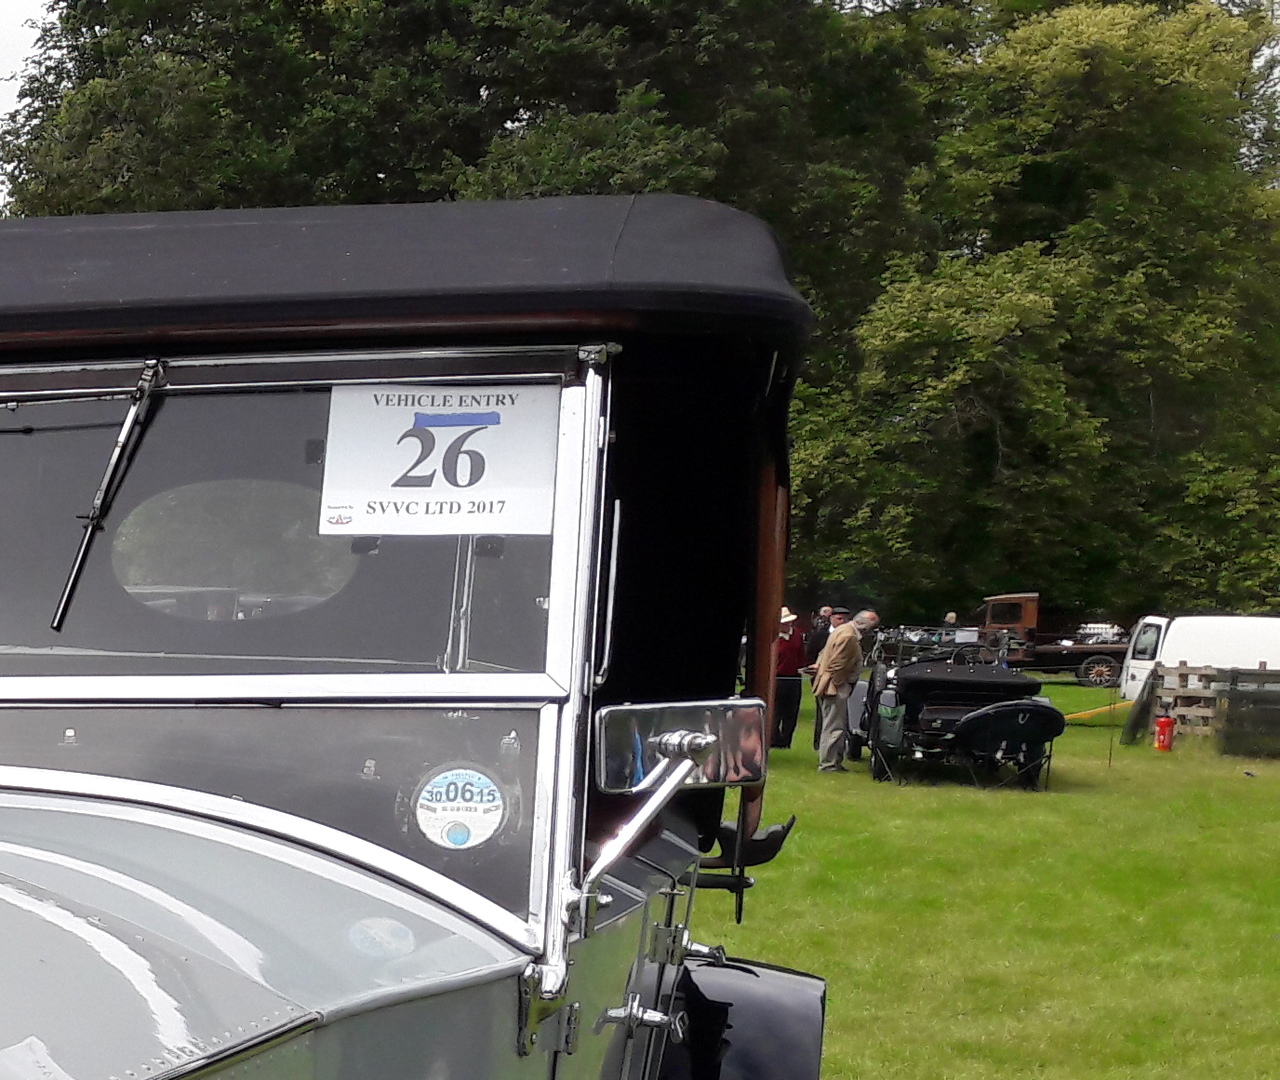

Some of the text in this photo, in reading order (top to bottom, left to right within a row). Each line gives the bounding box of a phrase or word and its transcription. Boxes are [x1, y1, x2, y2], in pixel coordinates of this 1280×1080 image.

[373, 393, 519, 407] VEHICLE ENTRY
[391, 425, 488, 488] 26
[366, 500, 506, 515] SVVC LTD 2017
[445, 781, 474, 803] 06
[477, 788, 496, 803] 15
